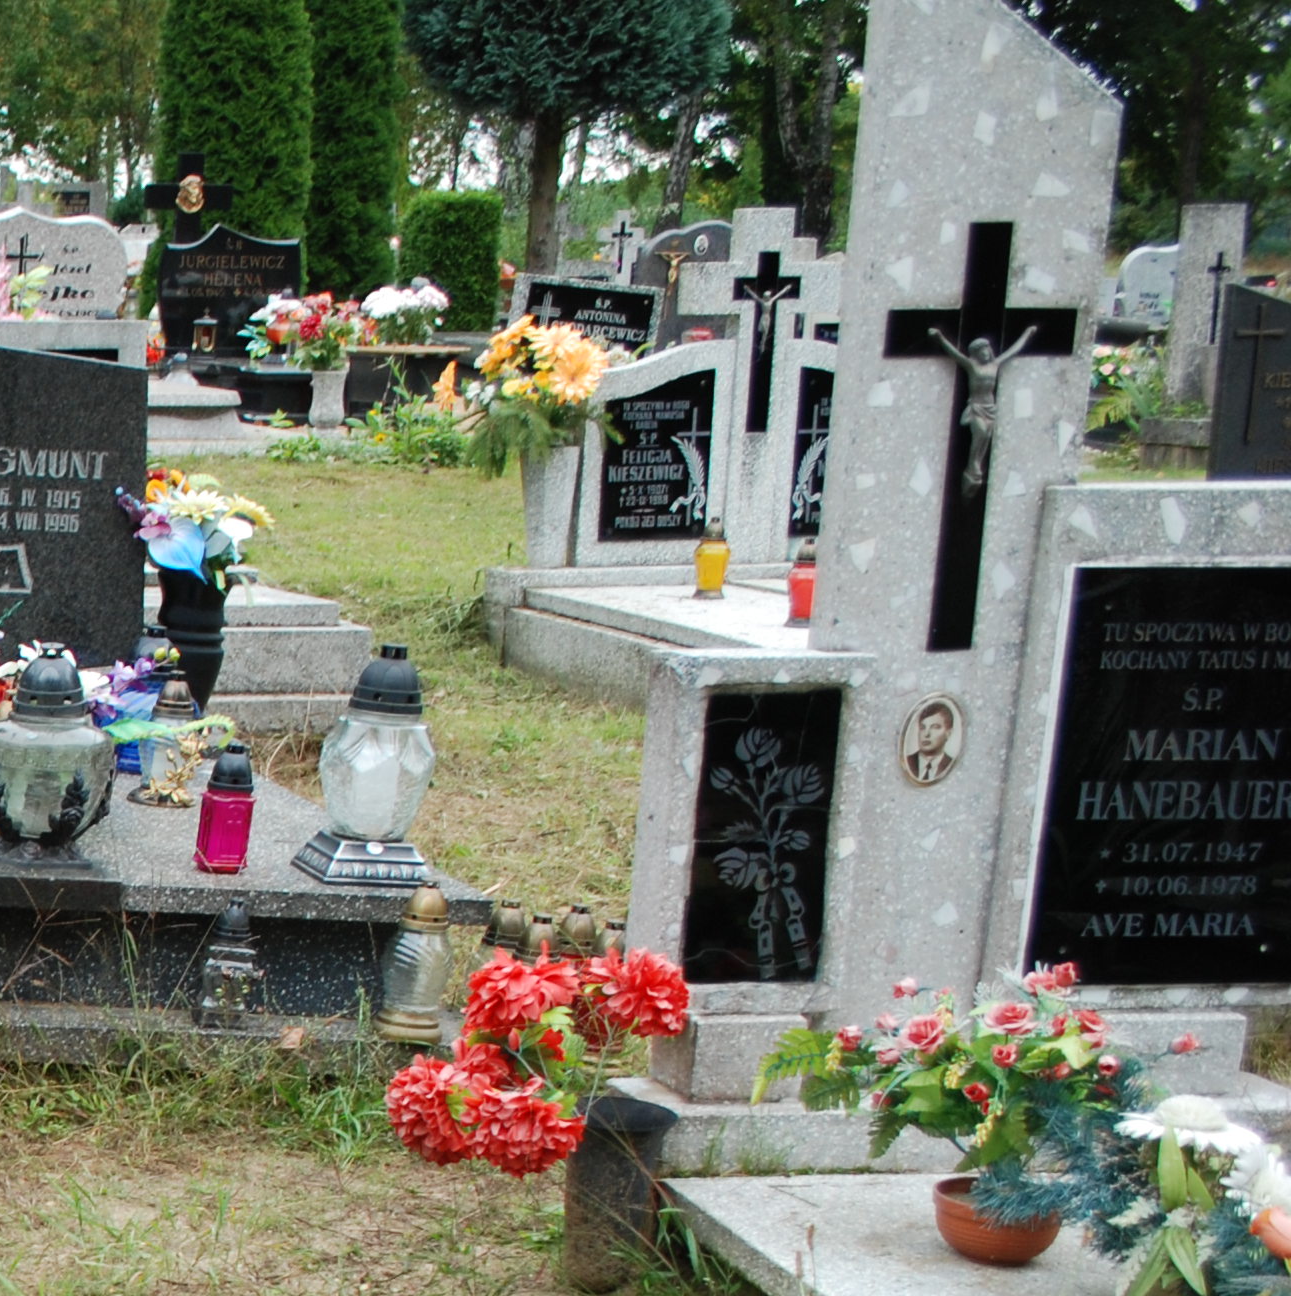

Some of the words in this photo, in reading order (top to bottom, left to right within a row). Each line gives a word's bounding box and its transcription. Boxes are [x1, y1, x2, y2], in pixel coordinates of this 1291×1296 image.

[179, 255, 286, 269] JURGIELEWICZ
[204, 273, 262, 286] HELENA
[574, 309, 627, 325] ANTONINA
[622, 448, 672, 465] FELICJA
[608, 464, 684, 483] KIESZEWICZ
[46, 489, 82, 510] 1915
[45, 512, 80, 533] 1996
[1103, 622, 1130, 642] TU
[1132, 622, 1236, 643] SPOCZYWA
[1242, 622, 1260, 642] W
[1099, 650, 1194, 670] KOCHANY
[1197, 647, 1258, 670] TATUŚ
[1261, 650, 1268, 670] I
[1182, 682, 1223, 712] Ś.P.
[1123, 729, 1282, 762] MARIAN
[1075, 780, 1291, 821] HANEBAUER
[1122, 842, 1263, 863] 31.07.1947
[1121, 875, 1258, 896] 10.06.1978
[1081, 912, 1145, 937] AVE
[1153, 912, 1255, 937] MARIA
